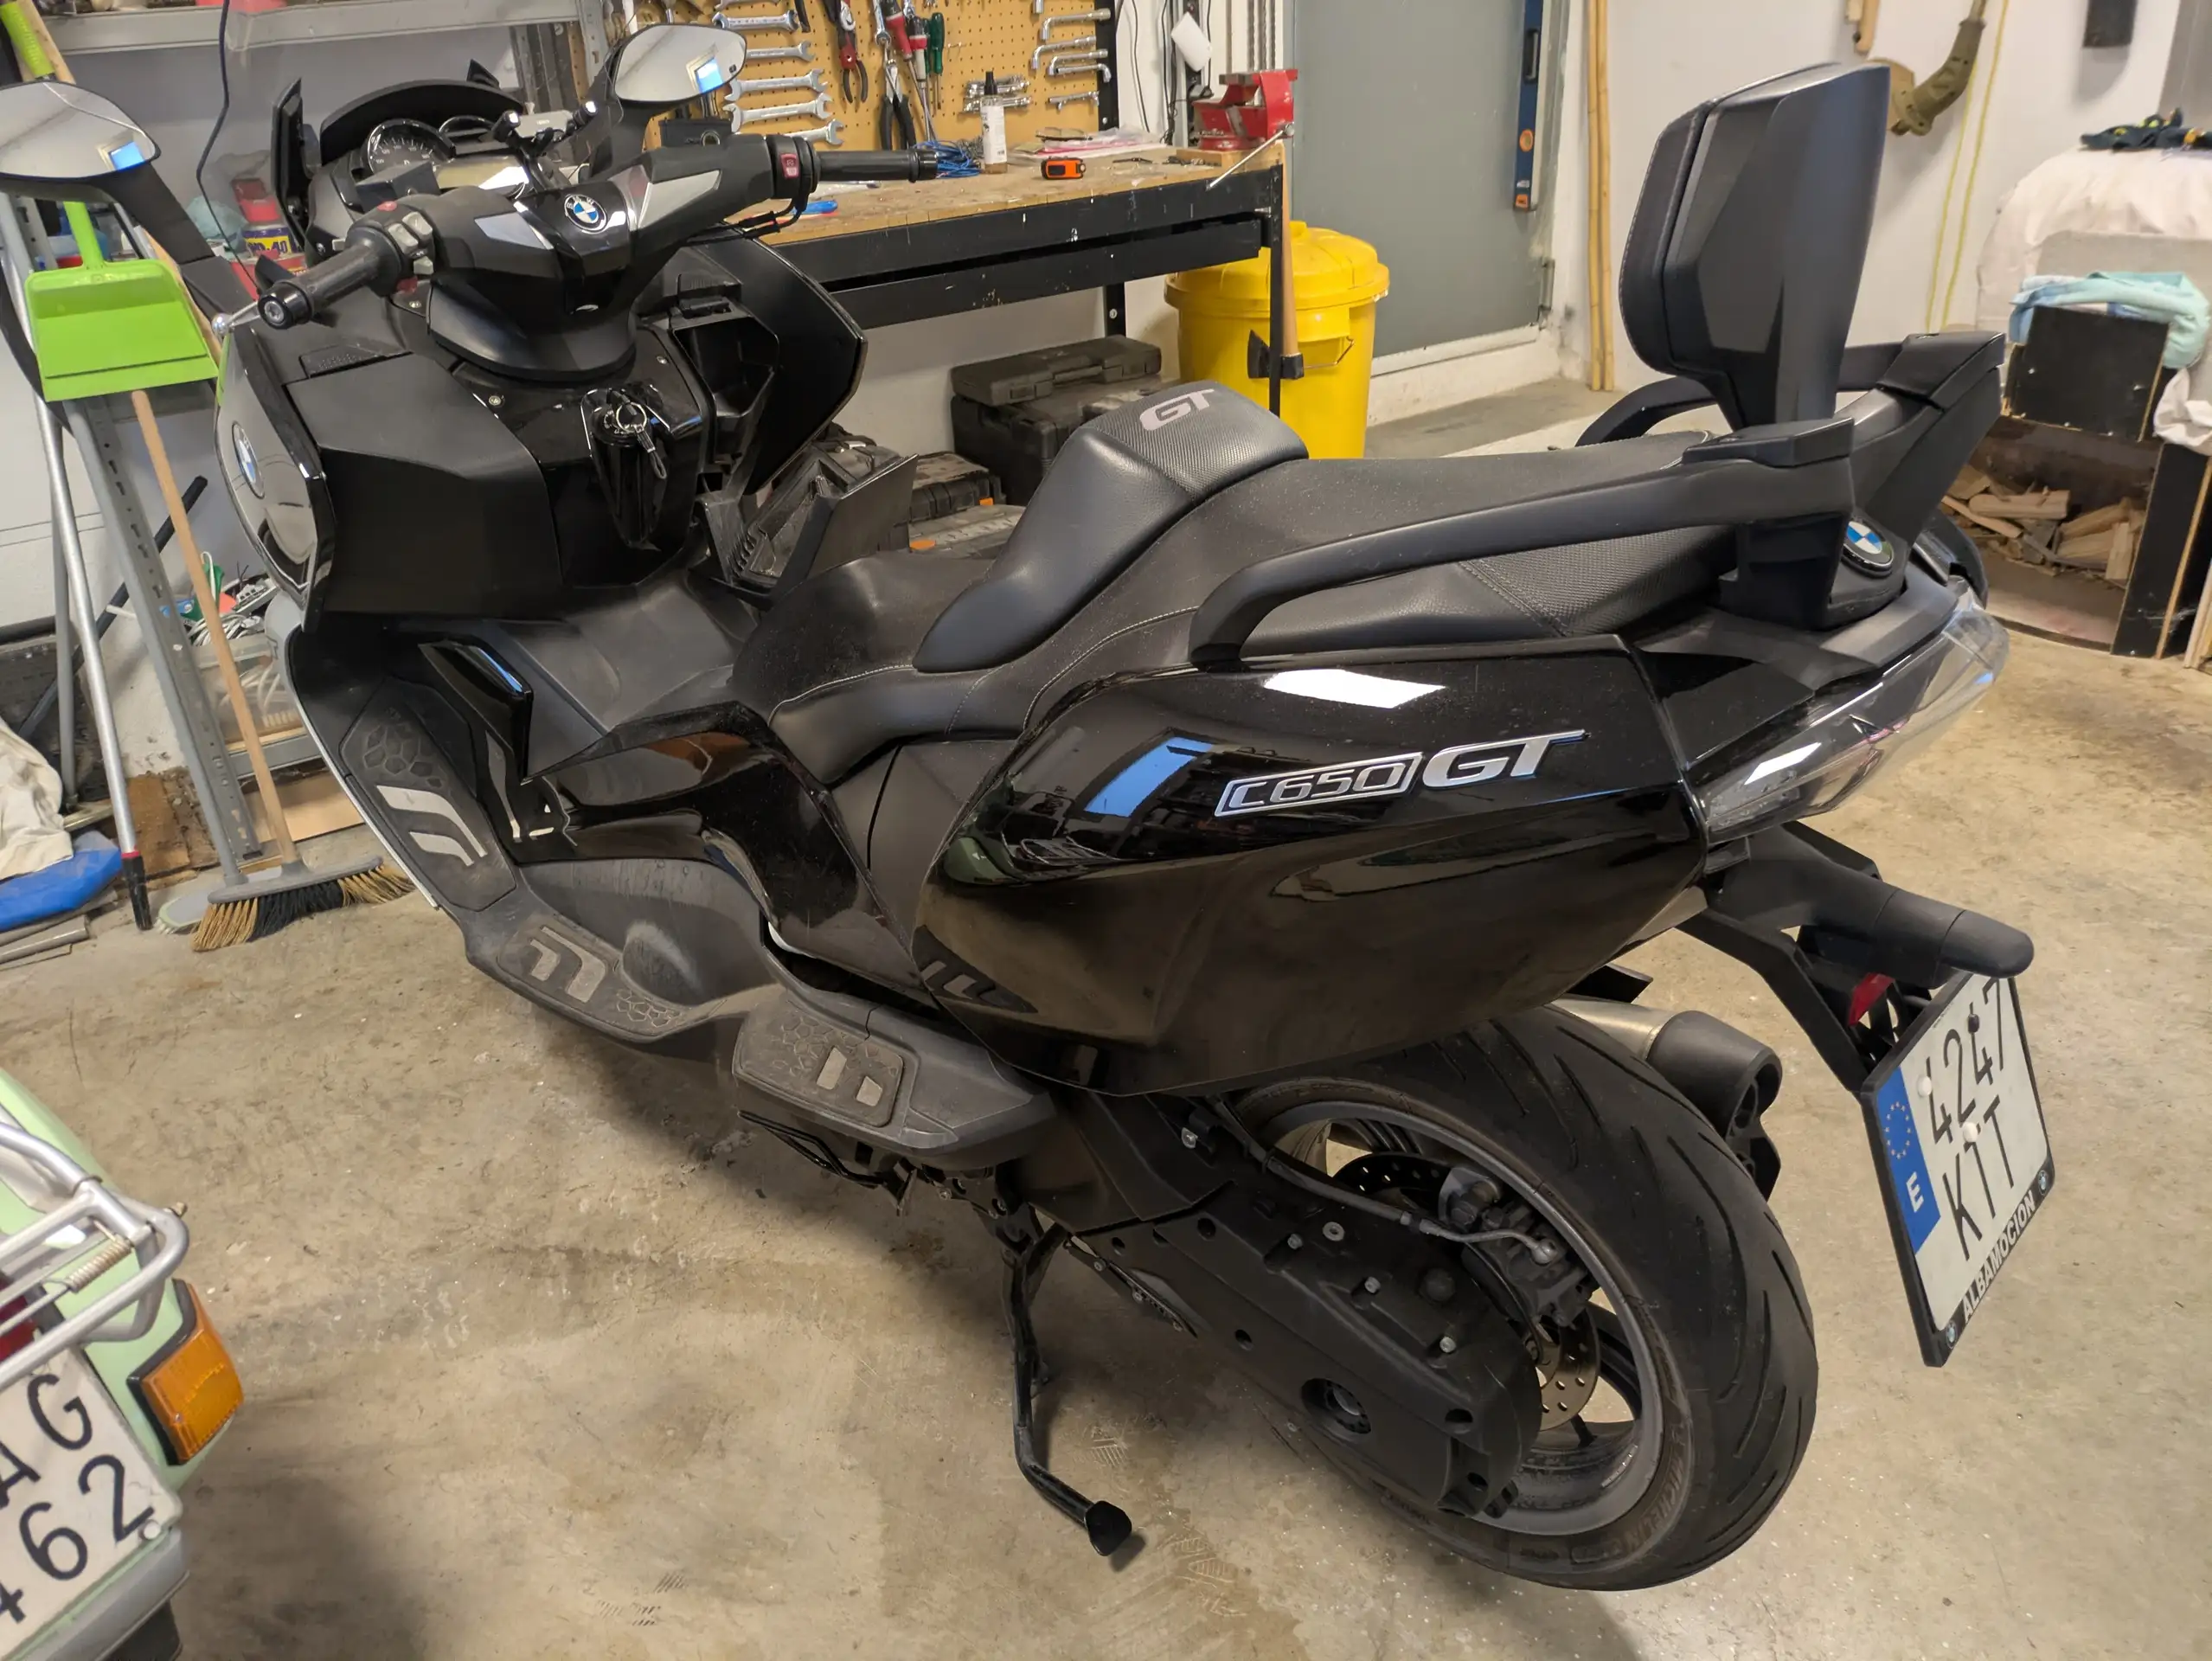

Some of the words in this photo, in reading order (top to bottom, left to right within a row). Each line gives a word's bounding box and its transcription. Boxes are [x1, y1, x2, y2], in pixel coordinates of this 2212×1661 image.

[1139, 388, 1215, 431] GT
[1228, 762, 1407, 810] C650
[1422, 728, 1587, 788] GT
[1926, 977, 2004, 1145] 4247
[1906, 1171, 1925, 1213] E
[1942, 1094, 2015, 1261] KTT
[1961, 1190, 2036, 1324] ALBAMOCION
